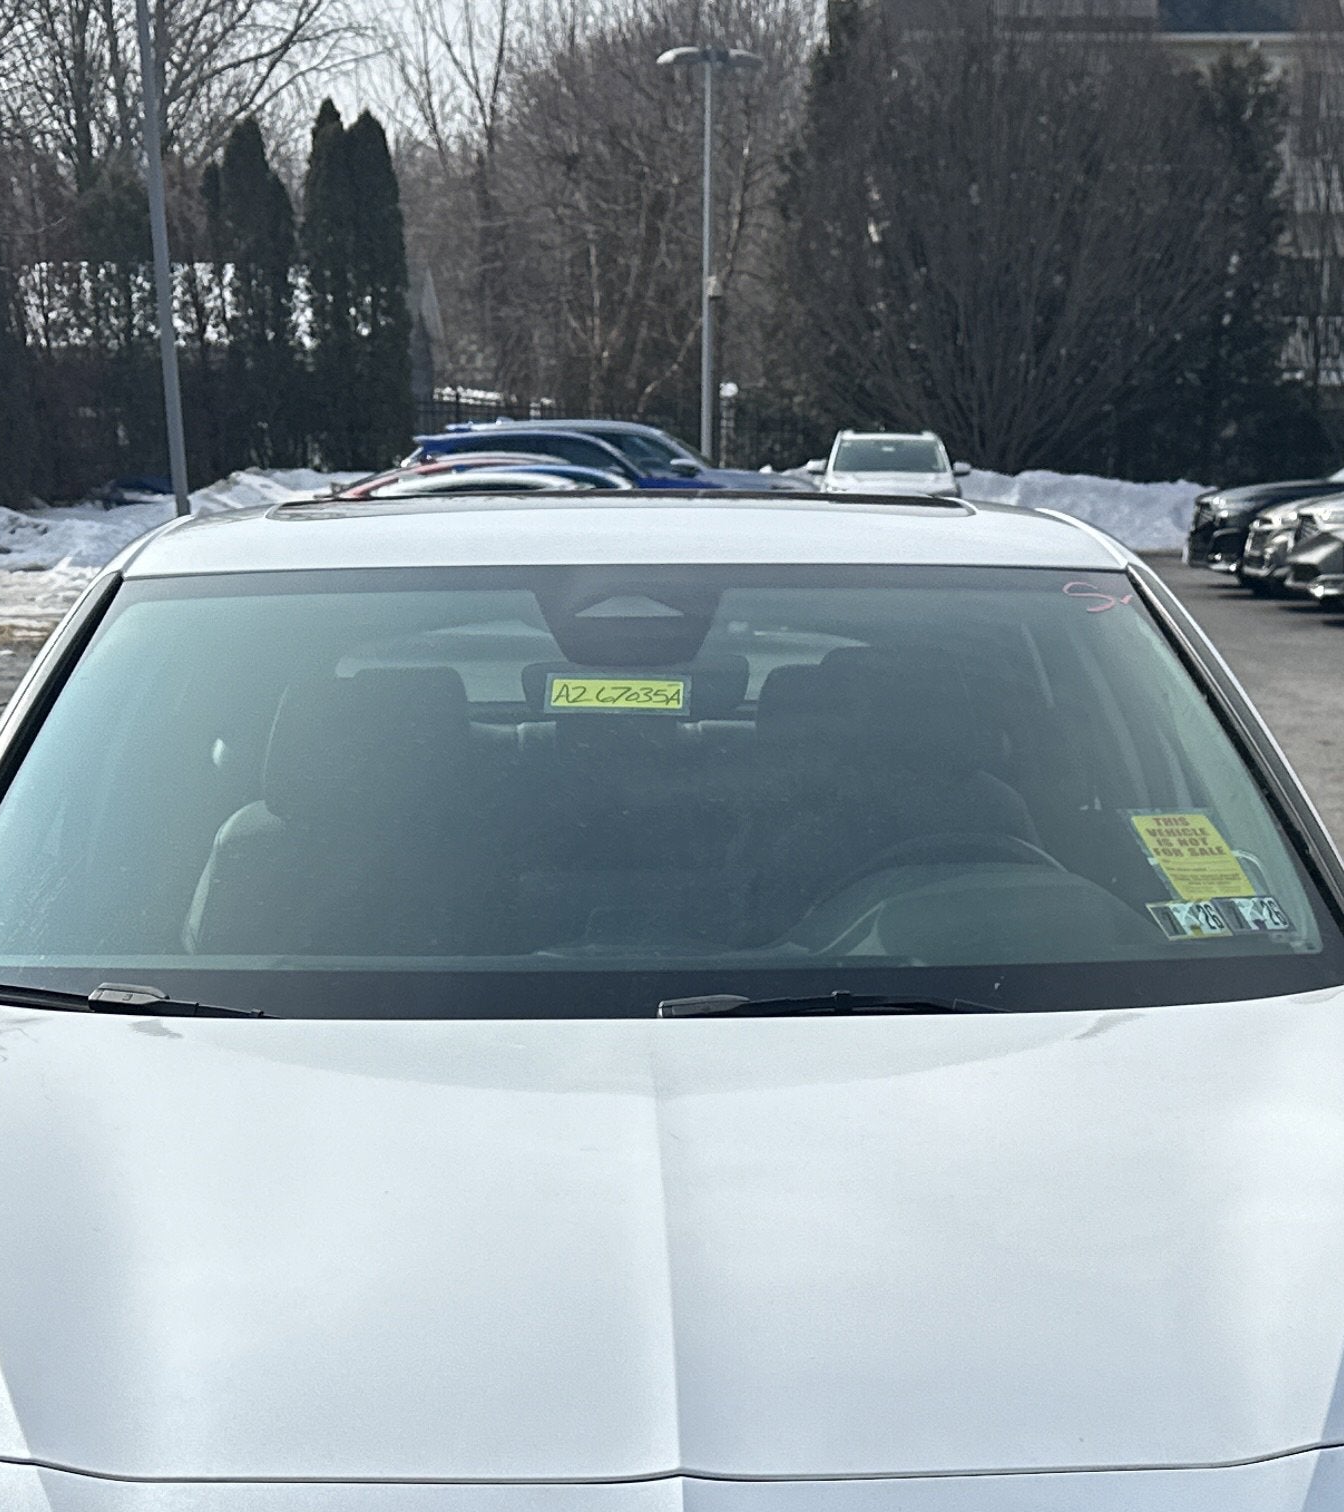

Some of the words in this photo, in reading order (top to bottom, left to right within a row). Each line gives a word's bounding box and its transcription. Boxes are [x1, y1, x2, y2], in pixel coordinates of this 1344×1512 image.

[1153, 817, 1190, 827] THIS
[1145, 827, 1211, 838] VEHICLE
[1156, 837, 1174, 848] IS
[1177, 837, 1210, 847] NOT
[1152, 847, 1185, 857] FOR
[1187, 846, 1228, 857] SALE
